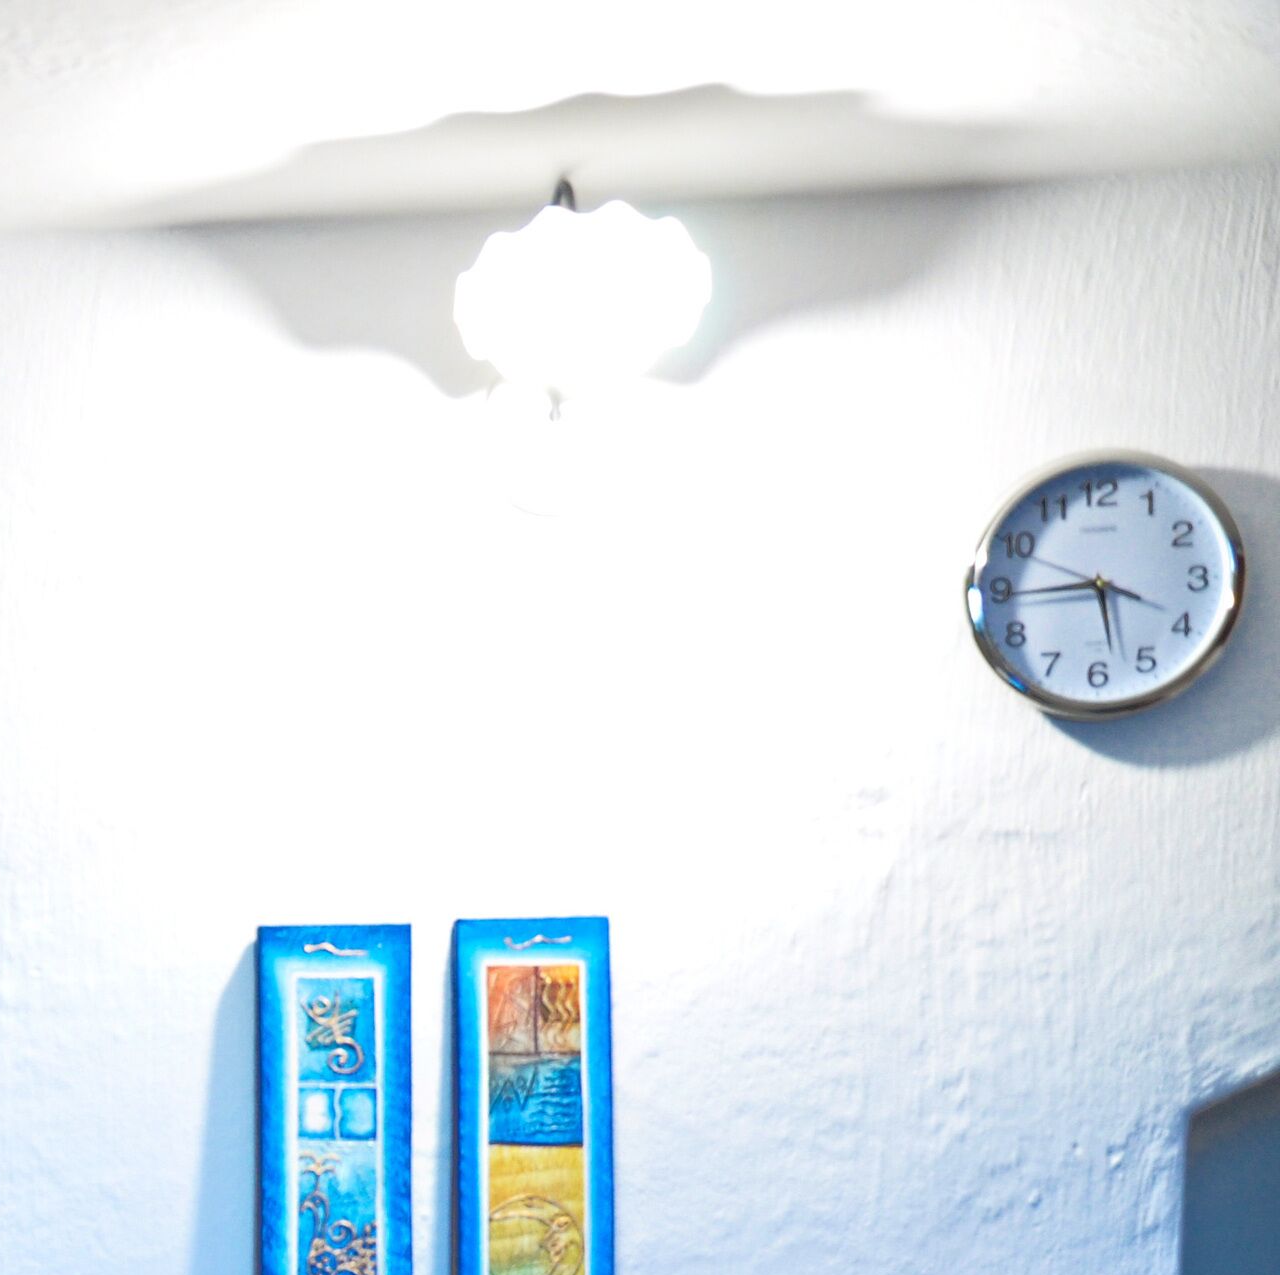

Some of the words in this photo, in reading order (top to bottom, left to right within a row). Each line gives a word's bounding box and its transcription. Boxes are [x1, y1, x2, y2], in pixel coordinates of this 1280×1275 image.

[1079, 479, 1118, 507] 12
[1139, 489, 1155, 516] 1
[1035, 494, 1068, 522] 11
[1003, 531, 1035, 559] 10
[1171, 520, 1194, 548] 2
[989, 577, 1012, 604] 9
[1187, 565, 1210, 592] 3
[1005, 621, 1026, 648] 8
[1171, 611, 1192, 637] 4
[1040, 652, 1061, 677] 7
[1135, 646, 1157, 674] 5
[1086, 661, 1109, 688] 6
